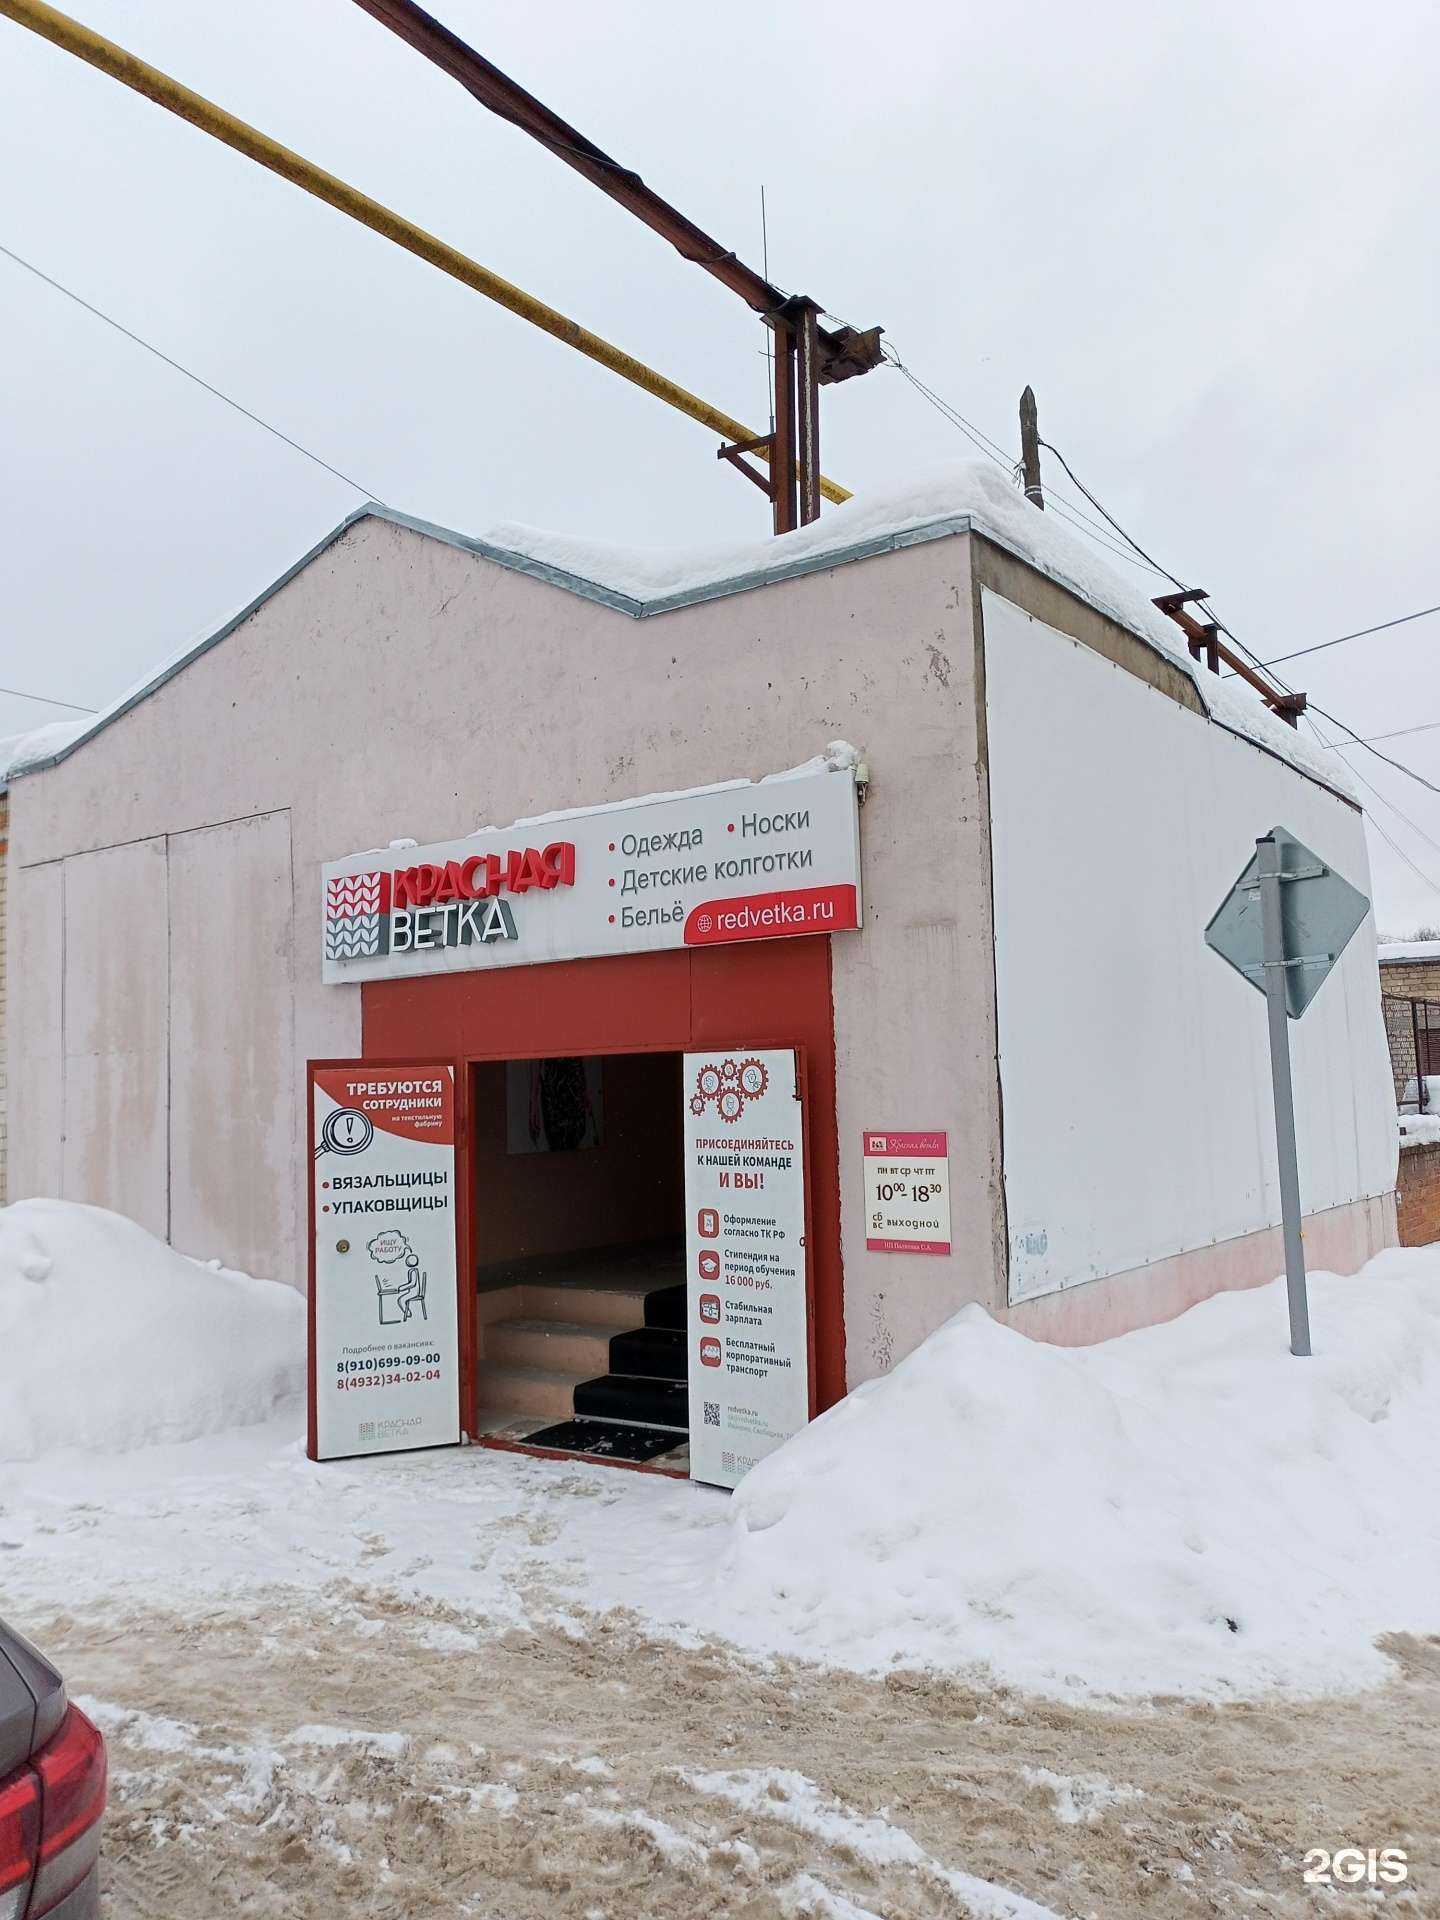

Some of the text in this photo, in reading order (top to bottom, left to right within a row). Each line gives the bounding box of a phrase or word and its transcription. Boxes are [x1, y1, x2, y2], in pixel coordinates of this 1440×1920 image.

[621, 810, 810, 857] Одежда Носки
[393, 841, 576, 910] КРАСНАЯ
[620, 850, 813, 896] Детские колготки
[621, 901, 684, 928] Бельё
[717, 901, 834, 930] redvetka.ru
[391, 897, 519, 952] ВЕТКА
[346, 1080, 442, 1096] ТРЕБУЮТСЯ
[363, 1097, 442, 1111] СОТРУДНИКИ
[695, 1137, 794, 1152] ПРИСОЕДИНЯЙТЕСЬ
[697, 1153, 792, 1170] К НАШЕЙ КОМАНДЕ
[332, 1171, 447, 1190] ВЯЗАЛЬЩИЦЫ
[719, 1172, 765, 1190] И ВЫ!
[332, 1195, 448, 1215] УПАКОВЩИЦЫ
[723, 1214, 776, 1228] Оформление
[886, 1218, 939, 1230] выходной
[723, 1228, 786, 1241] согласно ТК РФ
[375, 1245, 402, 1254] РАБОТУ
[724, 1249, 780, 1263] Стипендия на
[724, 1264, 796, 1277] период обучения
[725, 1275, 773, 1291] 16 000 руб.
[725, 1300, 773, 1315] Стабильная
[725, 1315, 762, 1326] зарплата
[342, 1344, 386, 1355] Подробнее
[726, 1337, 776, 1353] Бесплатный
[336, 1353, 441, 1373] 8(910)699-09-00
[726, 1352, 792, 1368] корпоративный
[726, 1363, 769, 1379] транспорт
[336, 1369, 441, 1391] 8(4932)34-02-04
